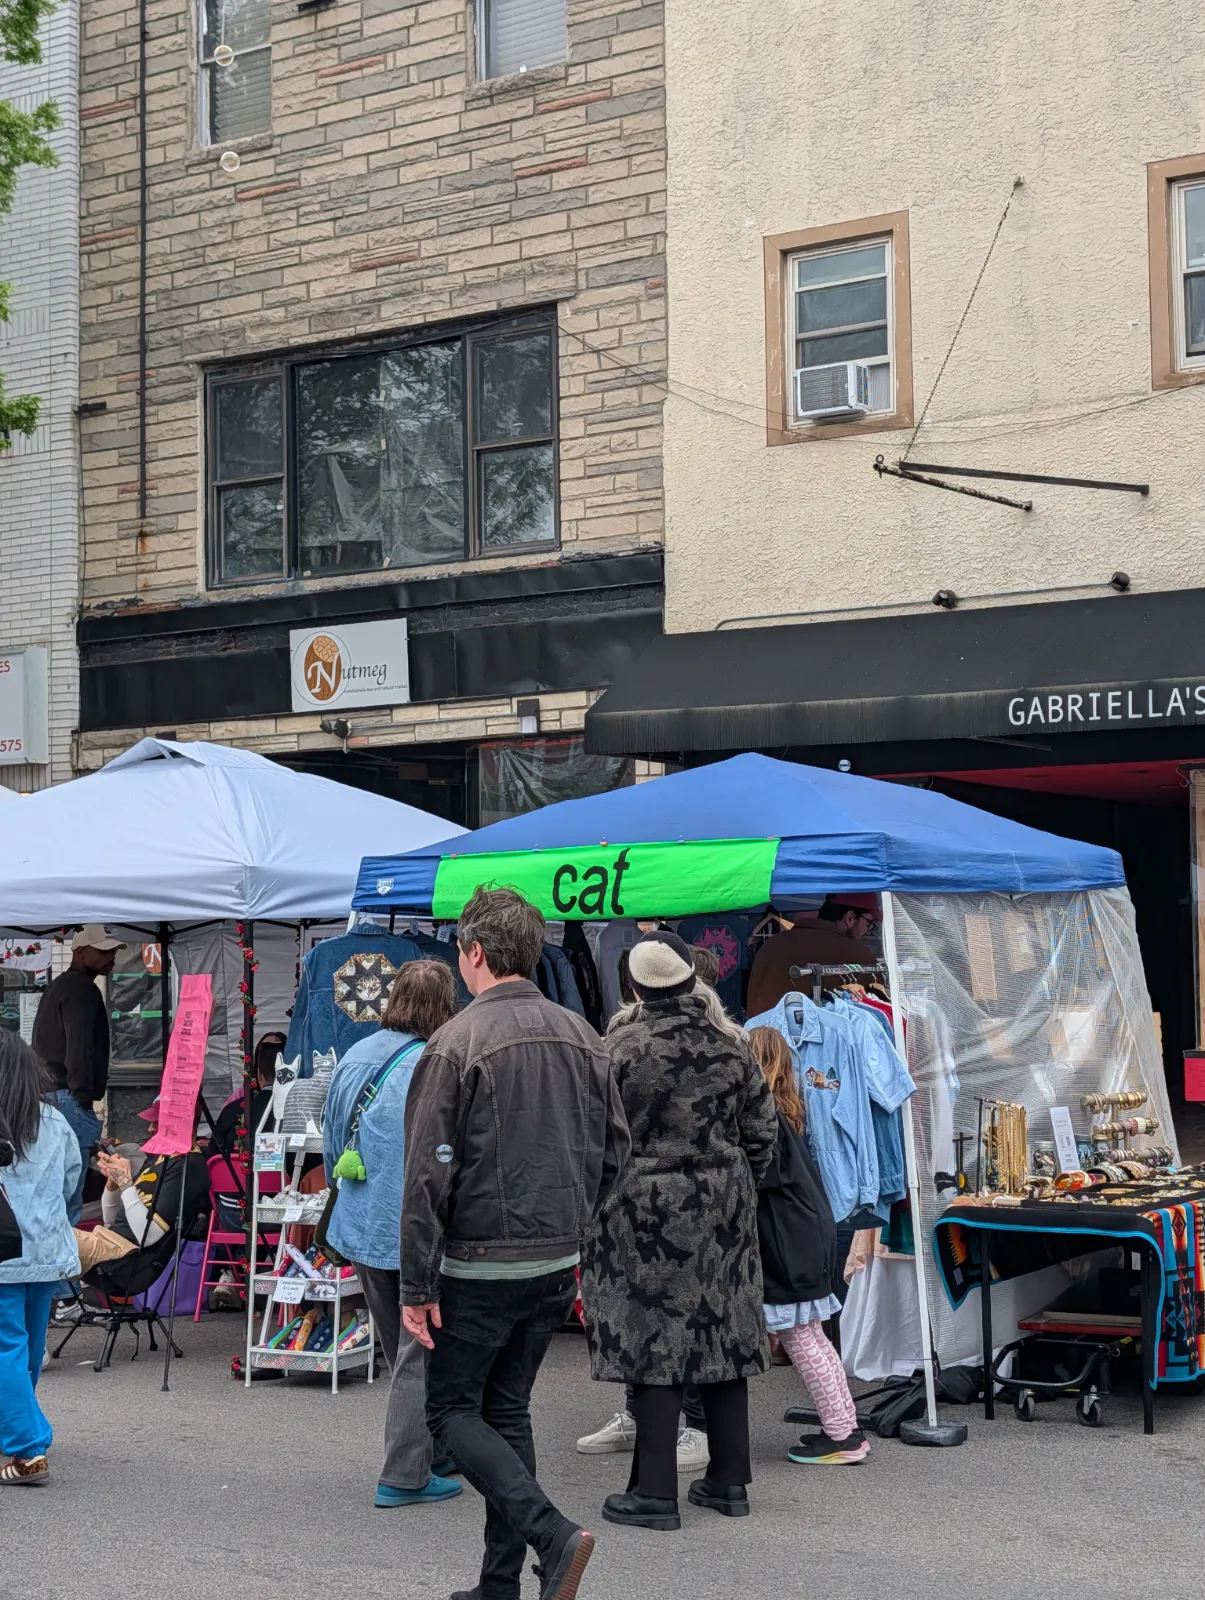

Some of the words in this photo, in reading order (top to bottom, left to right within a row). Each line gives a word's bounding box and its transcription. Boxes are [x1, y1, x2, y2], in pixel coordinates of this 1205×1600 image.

[307, 651, 387, 693] Nutmeg
[1008, 686, 1205, 725] GABRIELLA'S
[553, 848, 631, 916] cat
